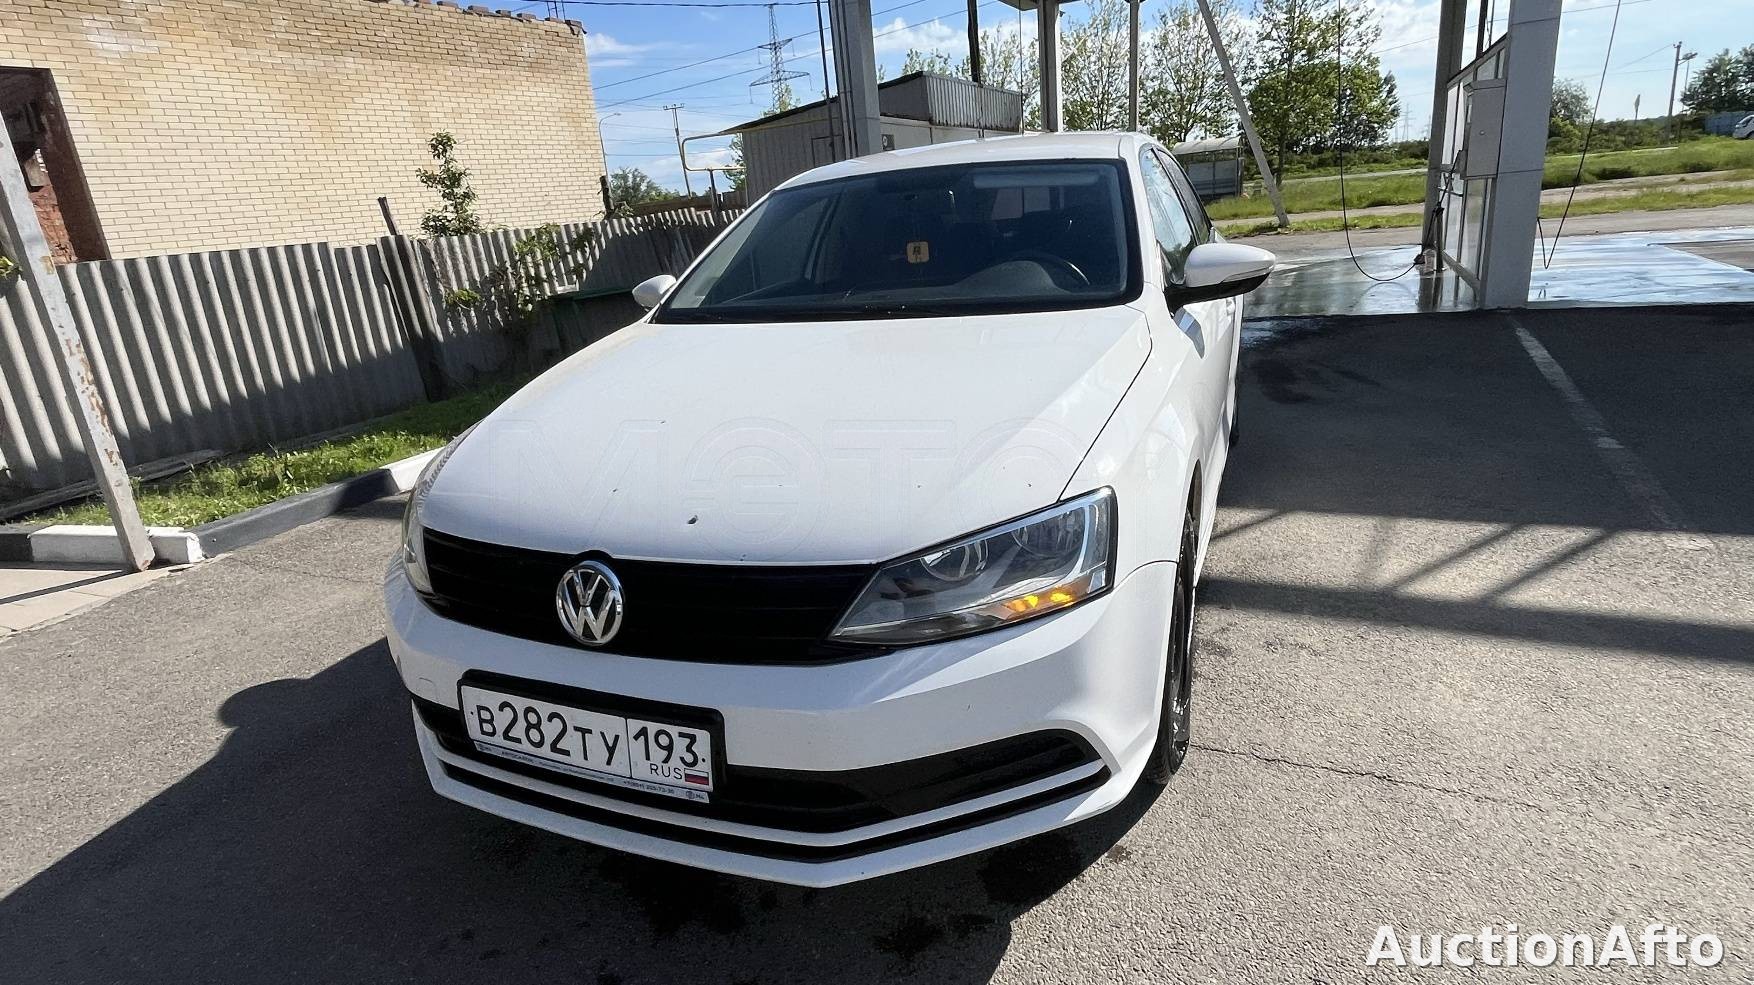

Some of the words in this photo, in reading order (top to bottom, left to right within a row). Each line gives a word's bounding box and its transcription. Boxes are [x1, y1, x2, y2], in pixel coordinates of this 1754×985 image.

[557, 562, 622, 645] VW
[632, 726, 699, 768] 193
[650, 763, 682, 780] RUS
